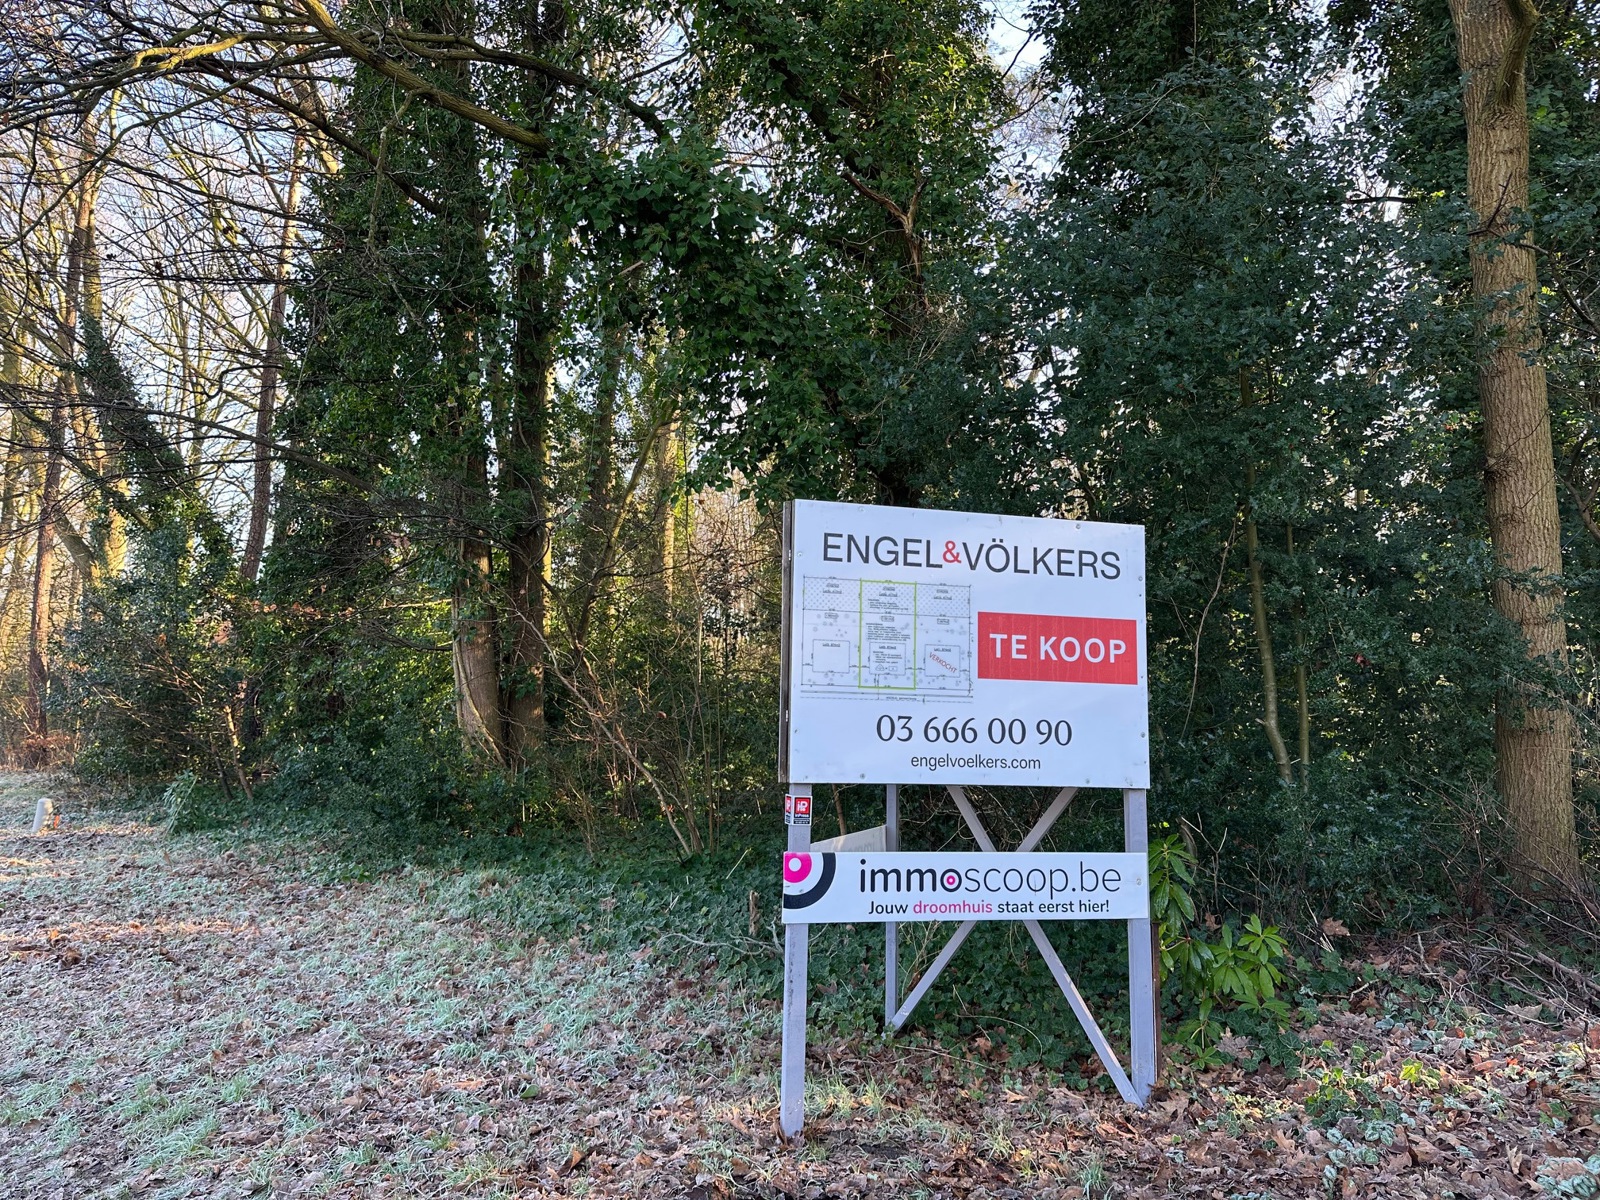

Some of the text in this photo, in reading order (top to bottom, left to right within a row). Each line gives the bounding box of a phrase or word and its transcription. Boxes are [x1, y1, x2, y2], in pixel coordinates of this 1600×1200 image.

[989, 633, 1127, 664] TE KOOP
[929, 652, 957, 673] VERKOCHT
[876, 714, 1073, 746] 03 666 00 90
[911, 753, 1041, 771] engelvoelkers.com
[860, 858, 1122, 900] immoscoop.be
[868, 899, 1110, 915] Jouw droomhuis staat eerst hier!
